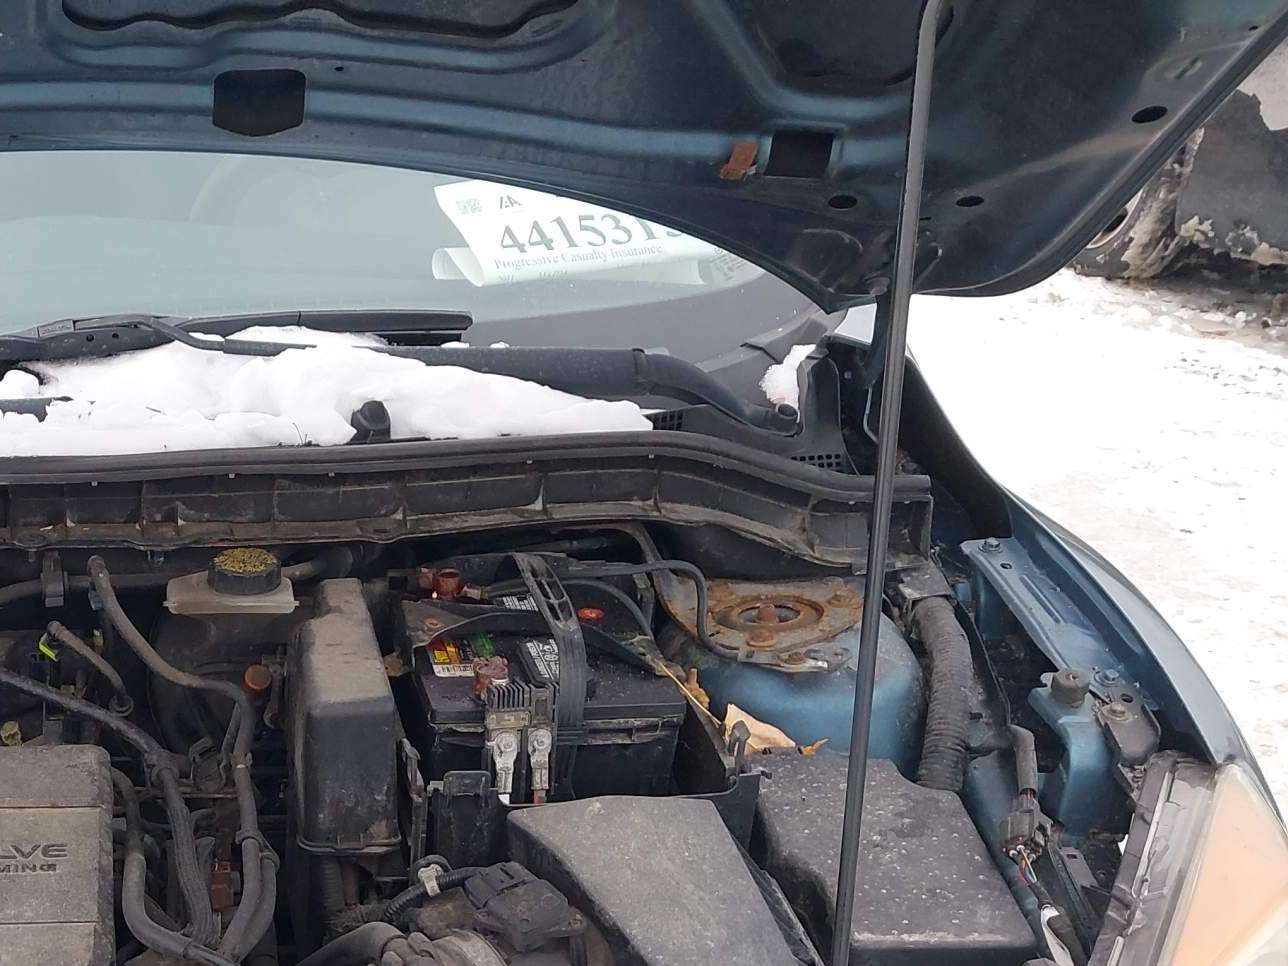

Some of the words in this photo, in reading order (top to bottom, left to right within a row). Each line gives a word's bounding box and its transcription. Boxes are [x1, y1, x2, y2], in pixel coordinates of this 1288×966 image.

[494, 255, 559, 270] Progressive
[561, 249, 608, 263] Casualty
[610, 245, 663, 259] Insurance
